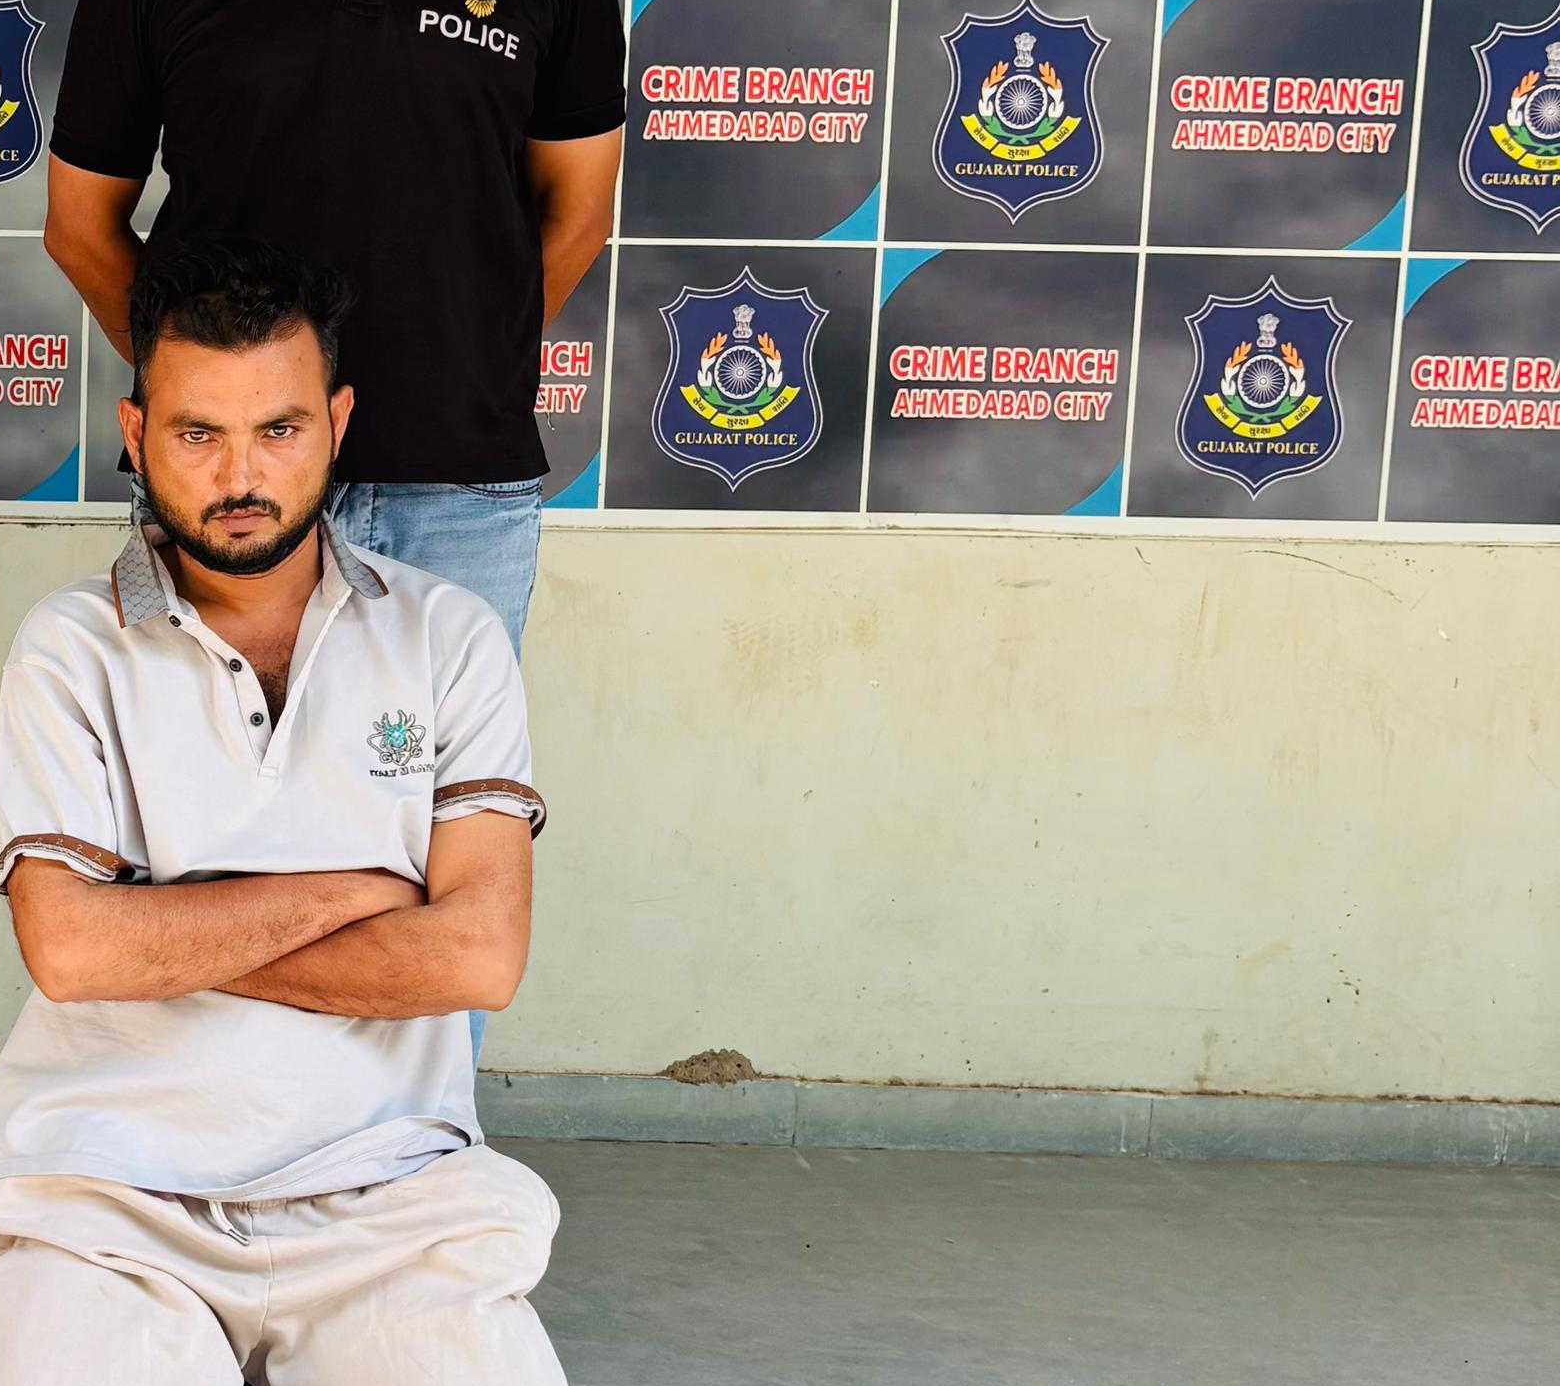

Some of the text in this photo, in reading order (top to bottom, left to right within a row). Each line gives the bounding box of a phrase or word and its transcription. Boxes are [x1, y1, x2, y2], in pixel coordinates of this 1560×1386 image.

[419, 9, 520, 60] POLICE
[641, 66, 874, 104] CRIME BRANCH
[1171, 76, 1403, 114] CRIME BRANCH
[644, 110, 866, 142] AHMEDABAD CITY
[1173, 120, 1394, 152] AHMEDABAD CITY
[955, 163, 1079, 177] GUJARAT POLICE
[1481, 173, 1549, 186] GUJARAT
[889, 346, 1118, 383] CRIME BRANCH
[1411, 355, 1508, 390] CRIME
[6, 377, 62, 406] CITY
[891, 389, 1111, 420] AHMEDABAD CITY
[675, 432, 798, 445] GUJARAT POLICE
[1197, 440, 1319, 454] GUJARAT POLICE
